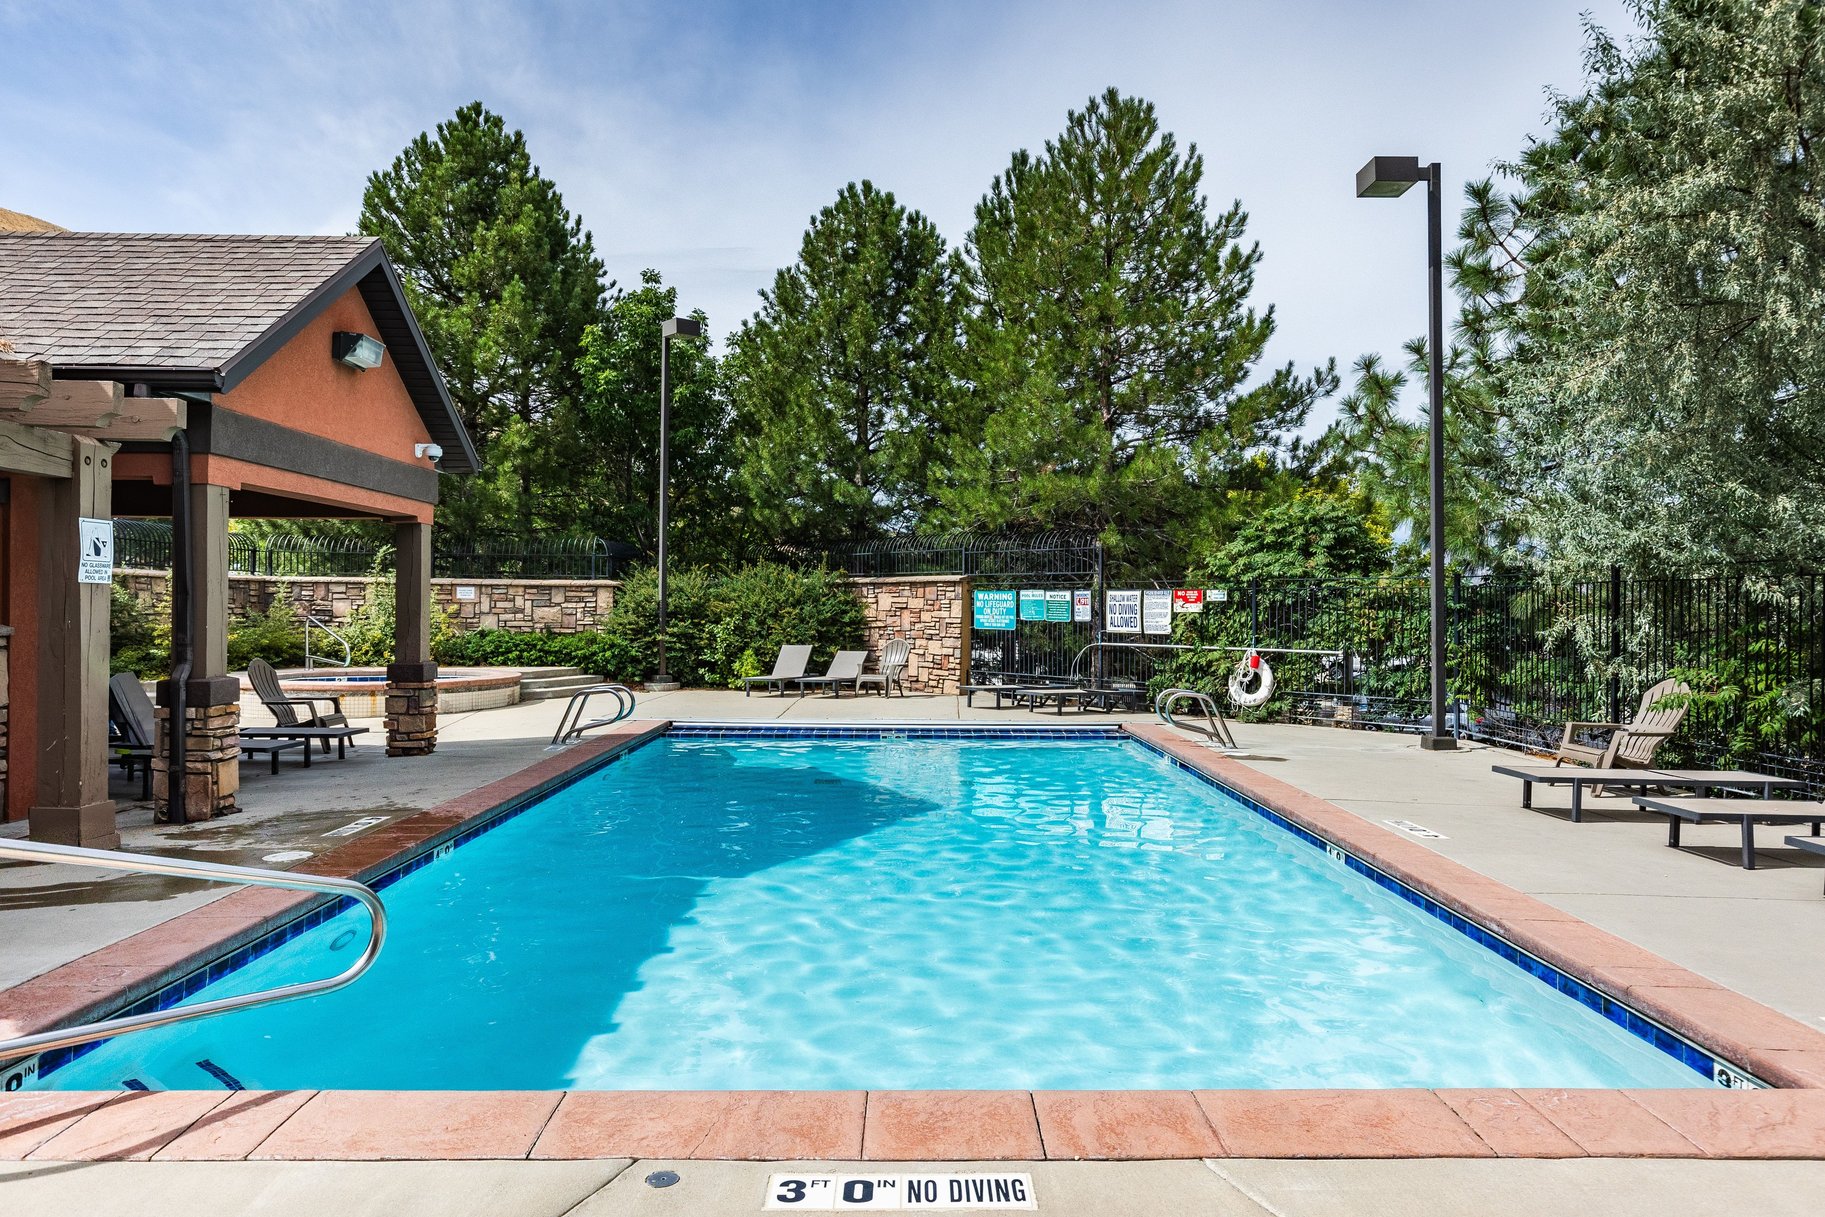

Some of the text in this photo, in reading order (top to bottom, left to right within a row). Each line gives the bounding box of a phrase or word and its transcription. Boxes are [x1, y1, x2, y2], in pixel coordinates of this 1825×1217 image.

[976, 600, 1014, 608] NO LIFEGUARD
[1081, 598, 1089, 606] 911
[1109, 594, 1138, 602] SHALLOW WATER
[984, 607, 1006, 615] ON DUTY
[1109, 603, 1138, 615] NO DIVING
[1109, 616, 1138, 628] ALLOWED
[24, 1063, 36, 1078] IN
[1733, 1075, 1744, 1089] FT
[777, 1179, 1027, 1203] 3 FT 0 IN NO DIVING
